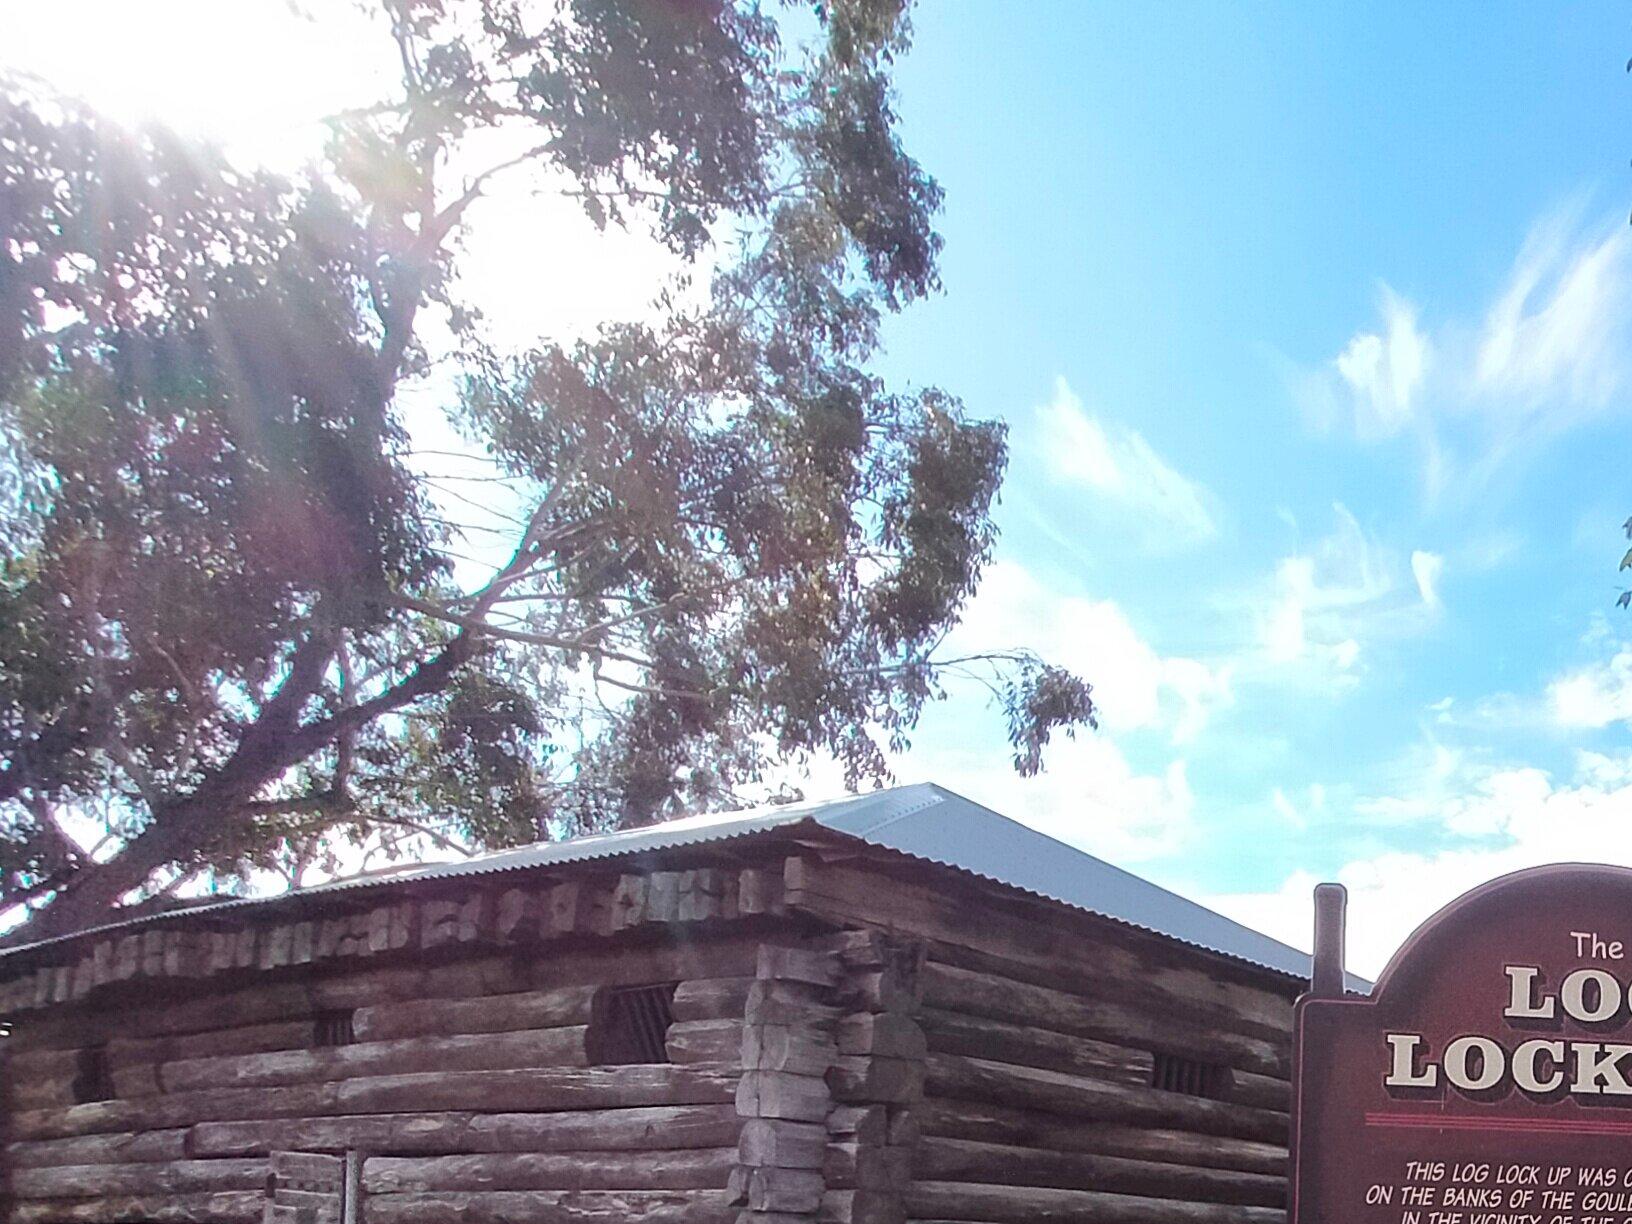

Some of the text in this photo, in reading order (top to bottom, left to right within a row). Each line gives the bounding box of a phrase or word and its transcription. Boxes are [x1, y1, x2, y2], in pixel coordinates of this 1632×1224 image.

[1569, 930, 1624, 960] The
[1406, 1161, 1445, 1182] THIS
[1452, 1163, 1490, 1183] LOG
[1496, 1164, 1541, 1185] LOCK
[1547, 1166, 1572, 1186] UP
[1578, 1167, 1617, 1187] WAS
[1365, 1184, 1394, 1205] ON
[1401, 1185, 1436, 1206] THE
[1442, 1187, 1503, 1208] BANKS
[1509, 1189, 1535, 1209] OF
[1541, 1190, 1576, 1210] THE
